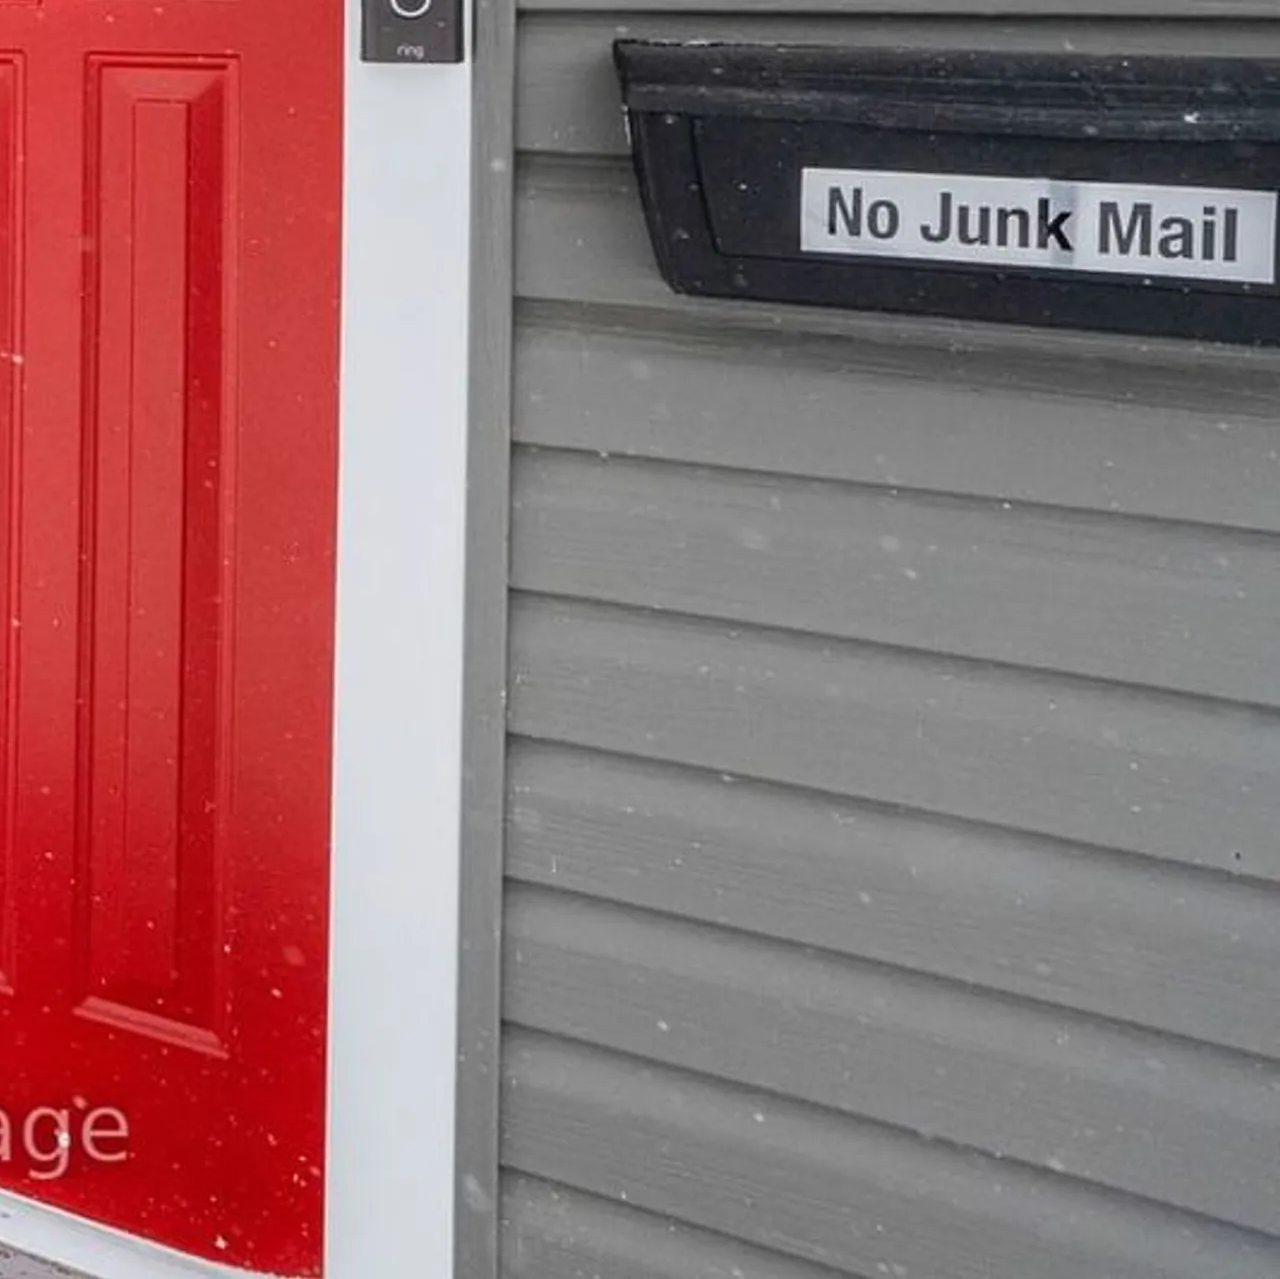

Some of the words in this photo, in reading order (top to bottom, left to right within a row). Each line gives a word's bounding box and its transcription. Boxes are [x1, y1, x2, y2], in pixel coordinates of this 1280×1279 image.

[396, 43, 424, 60] ring
[827, 186, 900, 239] No
[920, 191, 1075, 251] Junk
[1098, 201, 1238, 262] Mail
